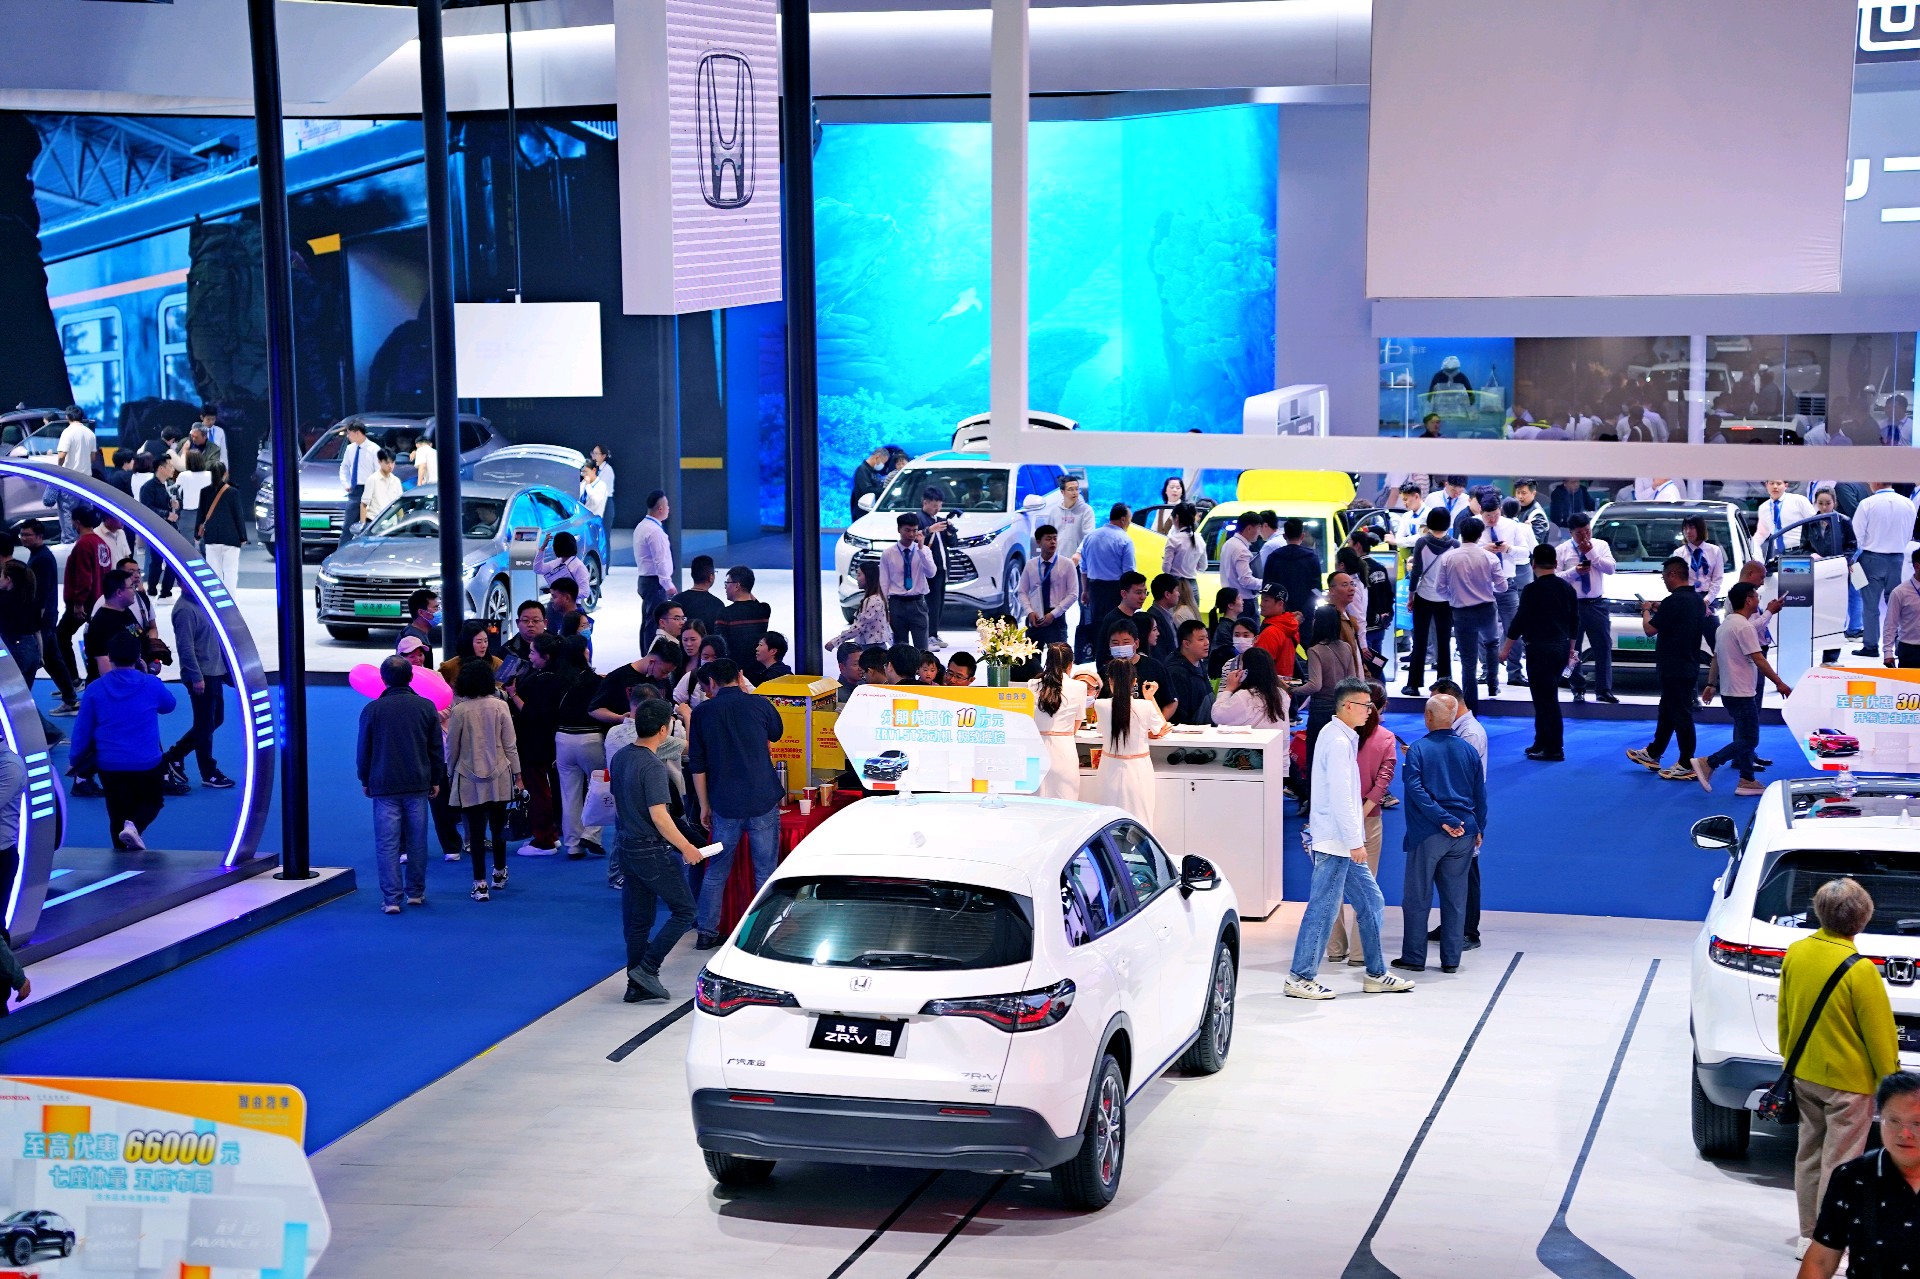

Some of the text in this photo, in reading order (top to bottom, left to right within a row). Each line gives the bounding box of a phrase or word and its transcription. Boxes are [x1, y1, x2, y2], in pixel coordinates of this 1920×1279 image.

[1836, 692, 1920, 711] 至高优惠 30
[881, 707, 1005, 728] 分期优惠价 10 万元
[956, 729, 1006, 745] 极致操控
[824, 1031, 868, 1045] ZR-V
[726, 1057, 767, 1067] 广汽本田
[961, 1072, 998, 1081] ZR-V
[23, 1129, 241, 1166] 至高优惠 66000 元
[49, 1164, 213, 1194] 七座体量 五座布局
